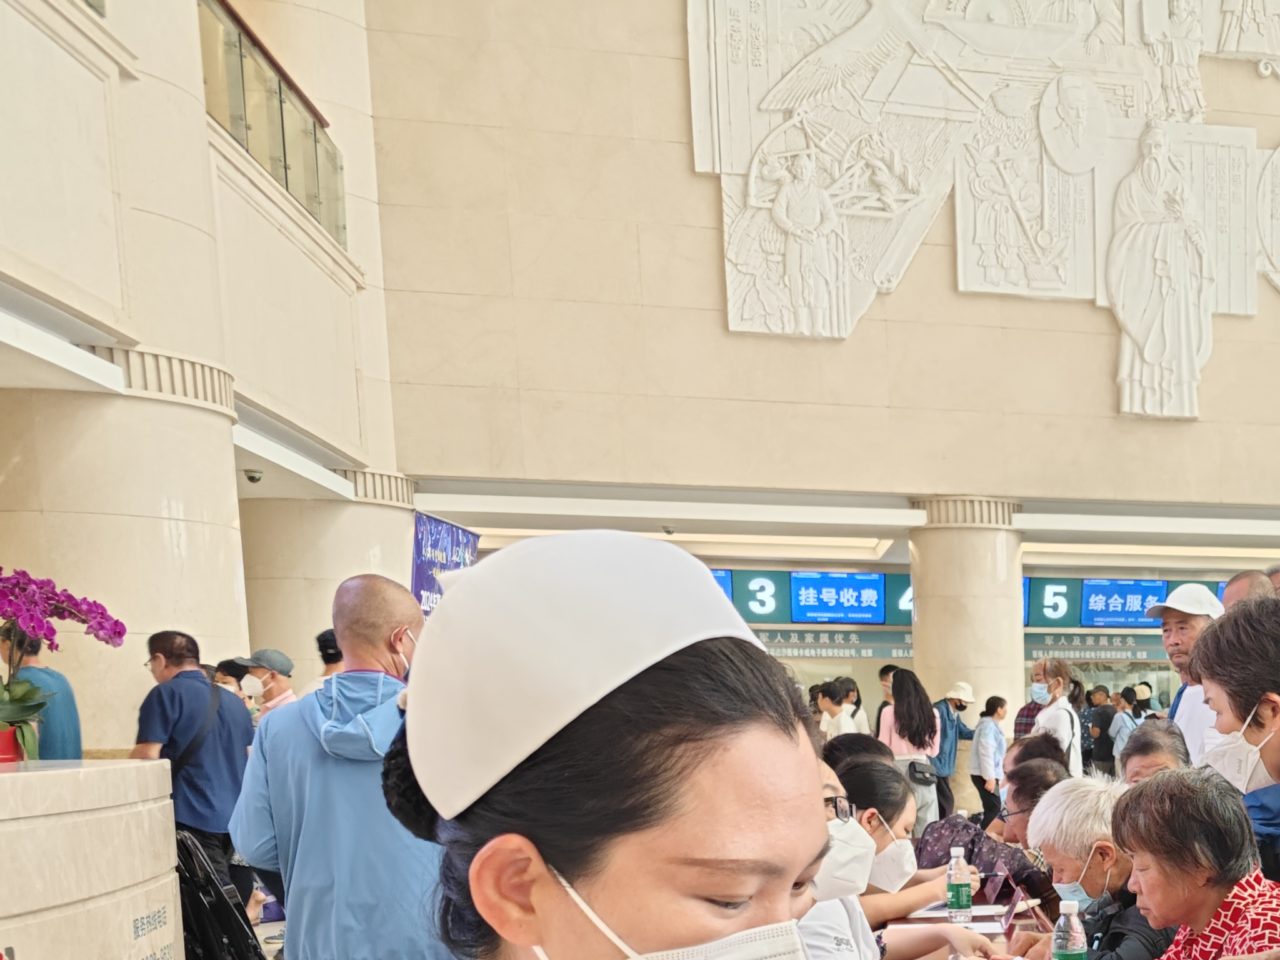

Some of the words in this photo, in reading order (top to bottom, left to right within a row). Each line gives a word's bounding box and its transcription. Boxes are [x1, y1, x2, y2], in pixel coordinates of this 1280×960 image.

[748, 577, 776, 615] 3
[798, 587, 879, 608] 挂号收费
[1042, 584, 1069, 620] 5
[1087, 593, 1160, 613] 综合服务
